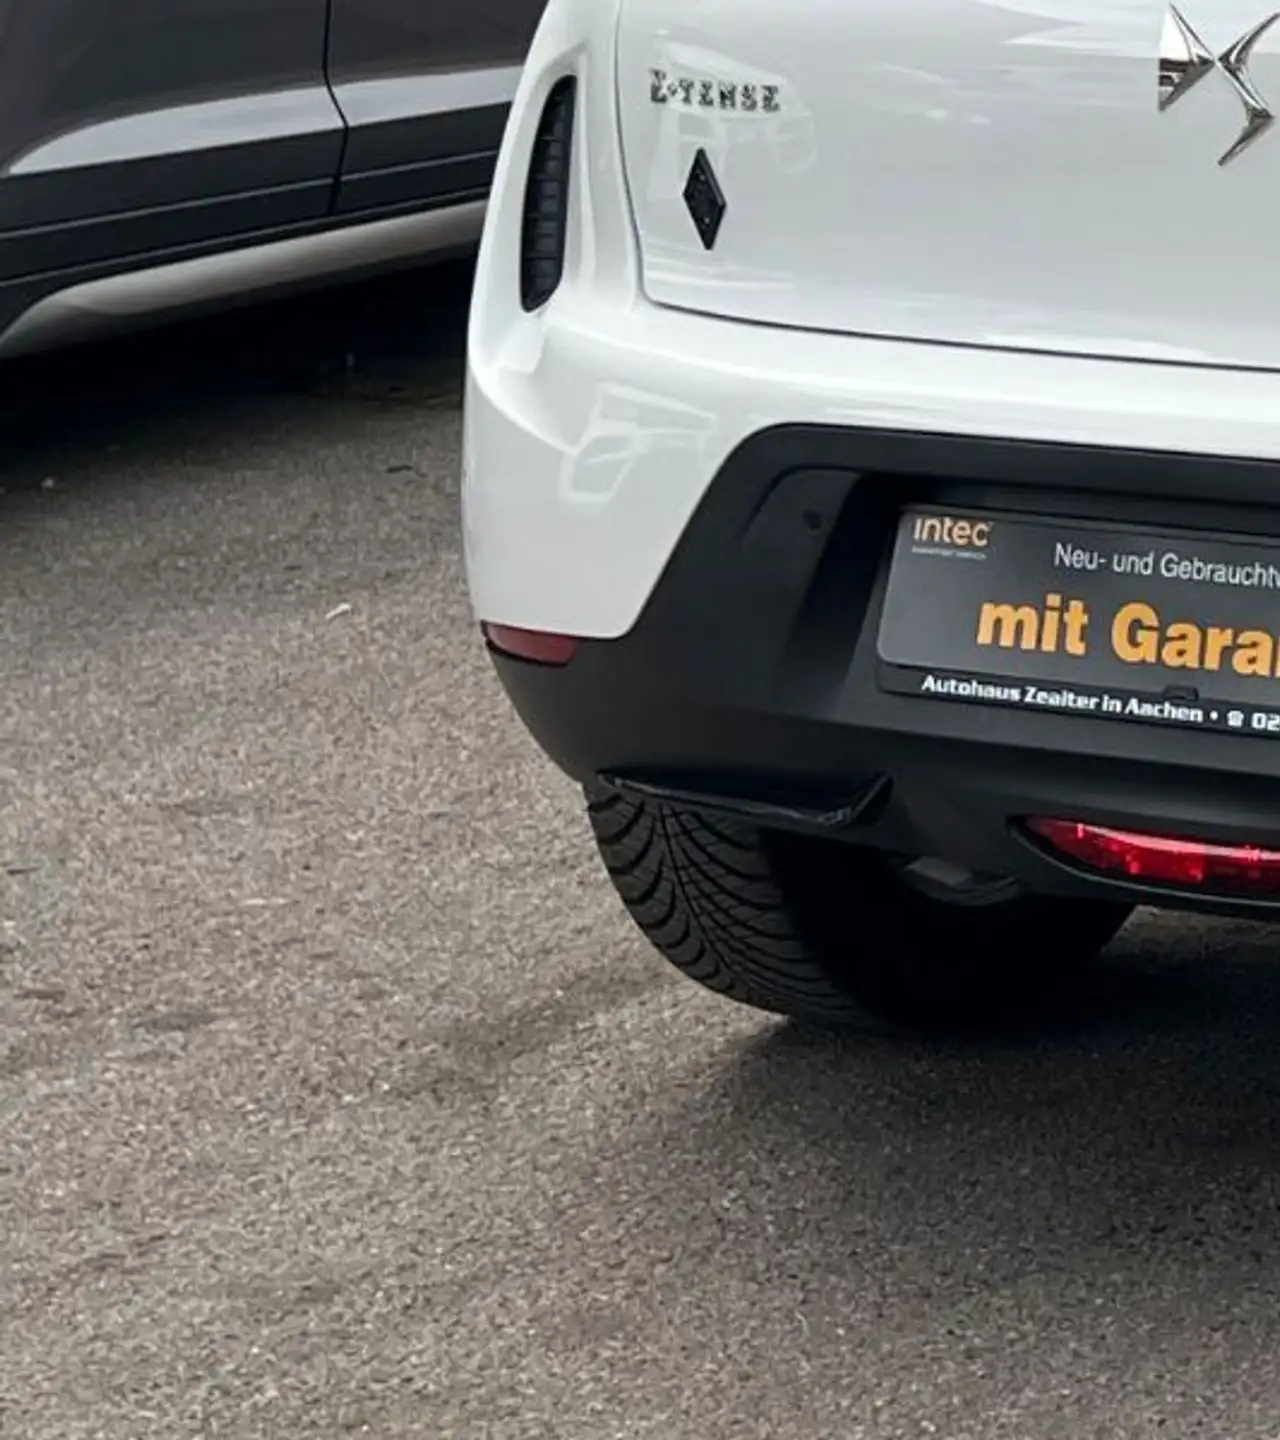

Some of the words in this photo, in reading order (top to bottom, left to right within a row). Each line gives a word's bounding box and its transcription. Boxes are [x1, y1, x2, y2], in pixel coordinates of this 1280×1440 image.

[1054, 542, 1107, 571] Neu-
[1112, 551, 1155, 576] und
[975, 593, 1089, 657] mit
[920, 673, 1020, 702] Autohaus
[1101, 694, 1123, 714] in
[1124, 696, 1205, 723] Aachen
